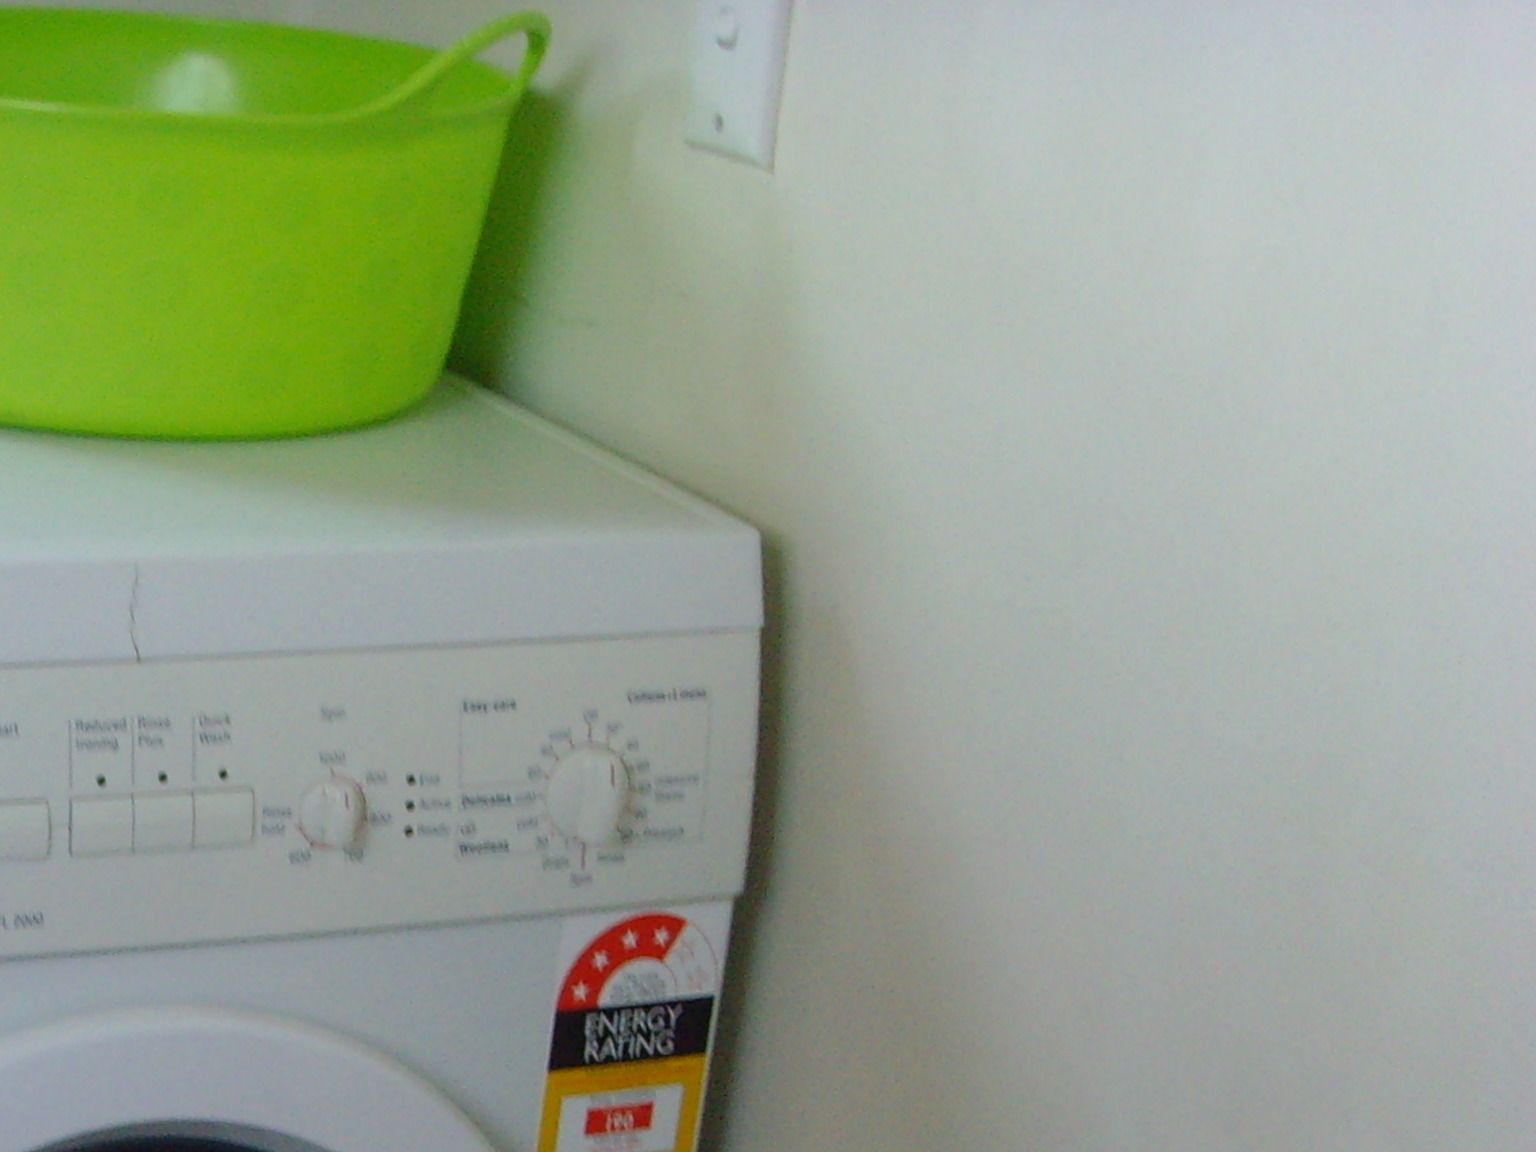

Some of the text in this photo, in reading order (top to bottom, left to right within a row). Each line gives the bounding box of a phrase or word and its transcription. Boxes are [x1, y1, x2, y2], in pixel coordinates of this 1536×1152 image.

[74, 717, 127, 733] Reduced
[137, 714, 171, 730] Rinse
[198, 713, 232, 728] Quick
[74, 738, 120, 752] Ironing
[137, 735, 165, 748] Plus
[198, 732, 232, 746] Wash
[584, 1003, 683, 1037] ENERGY
[584, 1030, 675, 1065] RATING
